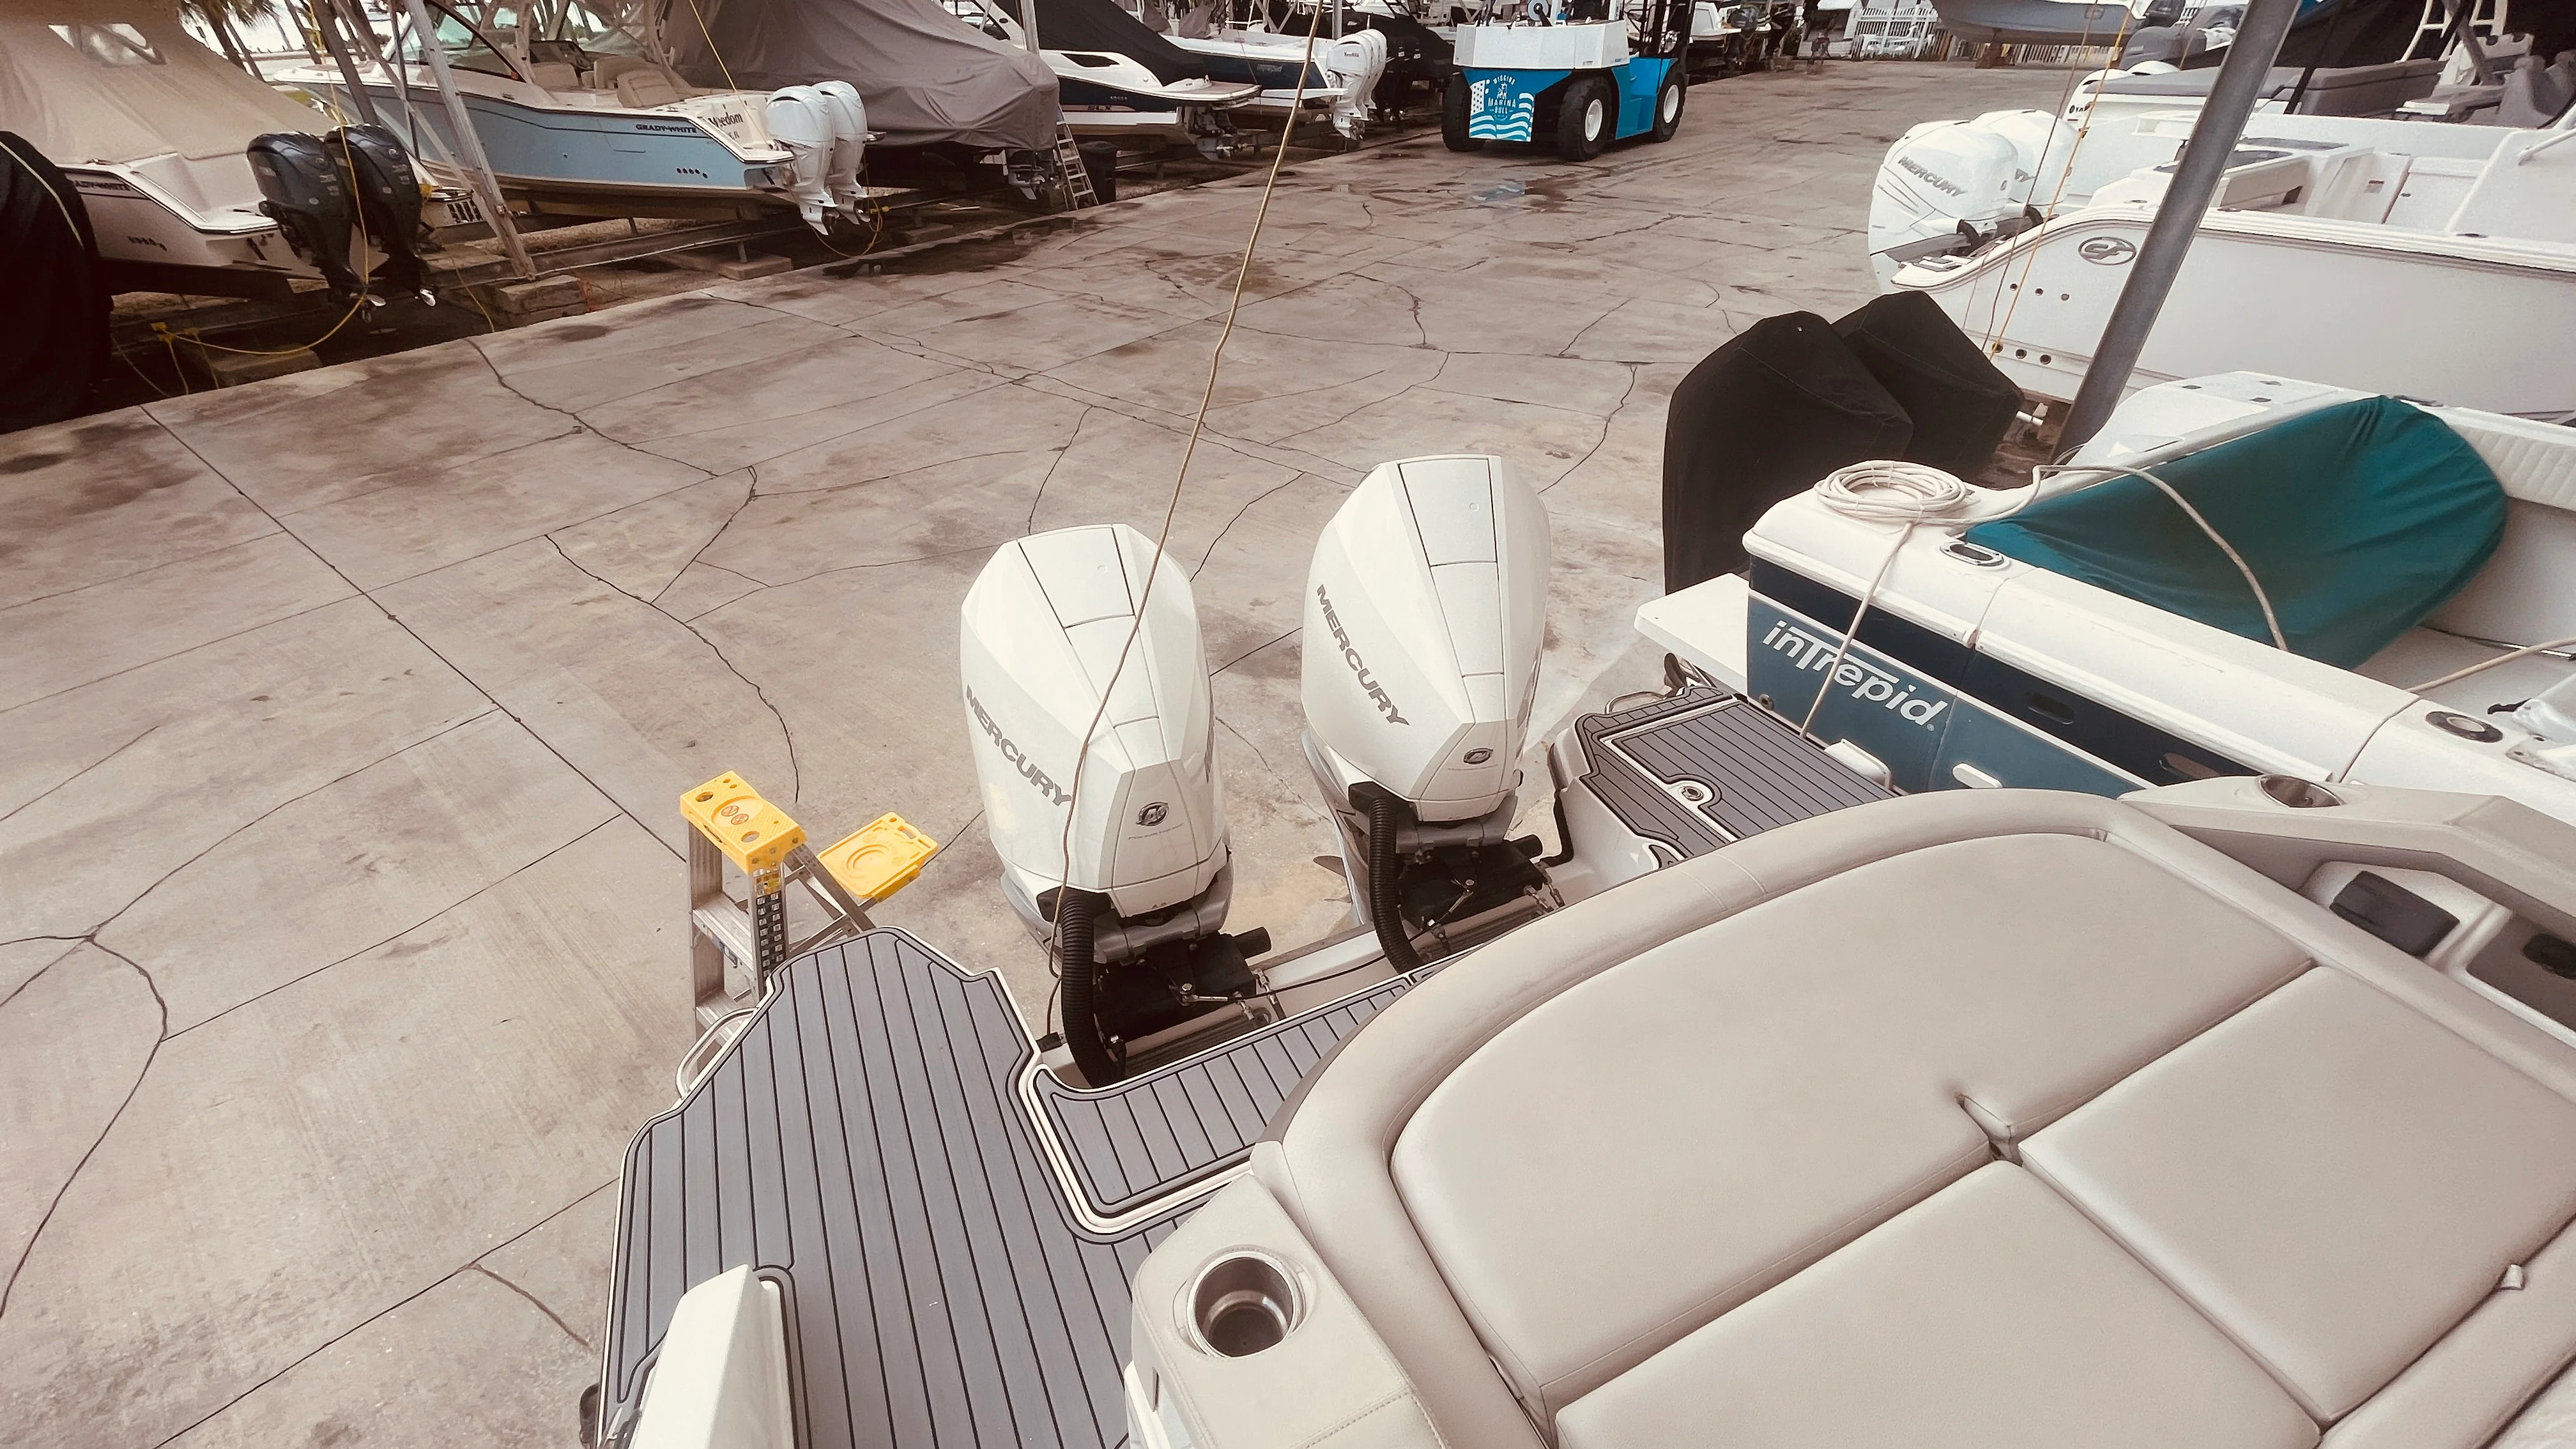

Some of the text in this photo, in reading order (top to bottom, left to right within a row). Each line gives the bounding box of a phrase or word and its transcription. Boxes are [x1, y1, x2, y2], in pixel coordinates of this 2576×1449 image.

[1487, 97, 1516, 108] MARINA
[636, 124, 697, 133] GRADY-WHITE
[1897, 155, 1968, 197] MERCURY
[1317, 584, 1410, 726] MERCURY
[966, 684, 1071, 806] MERCURY
